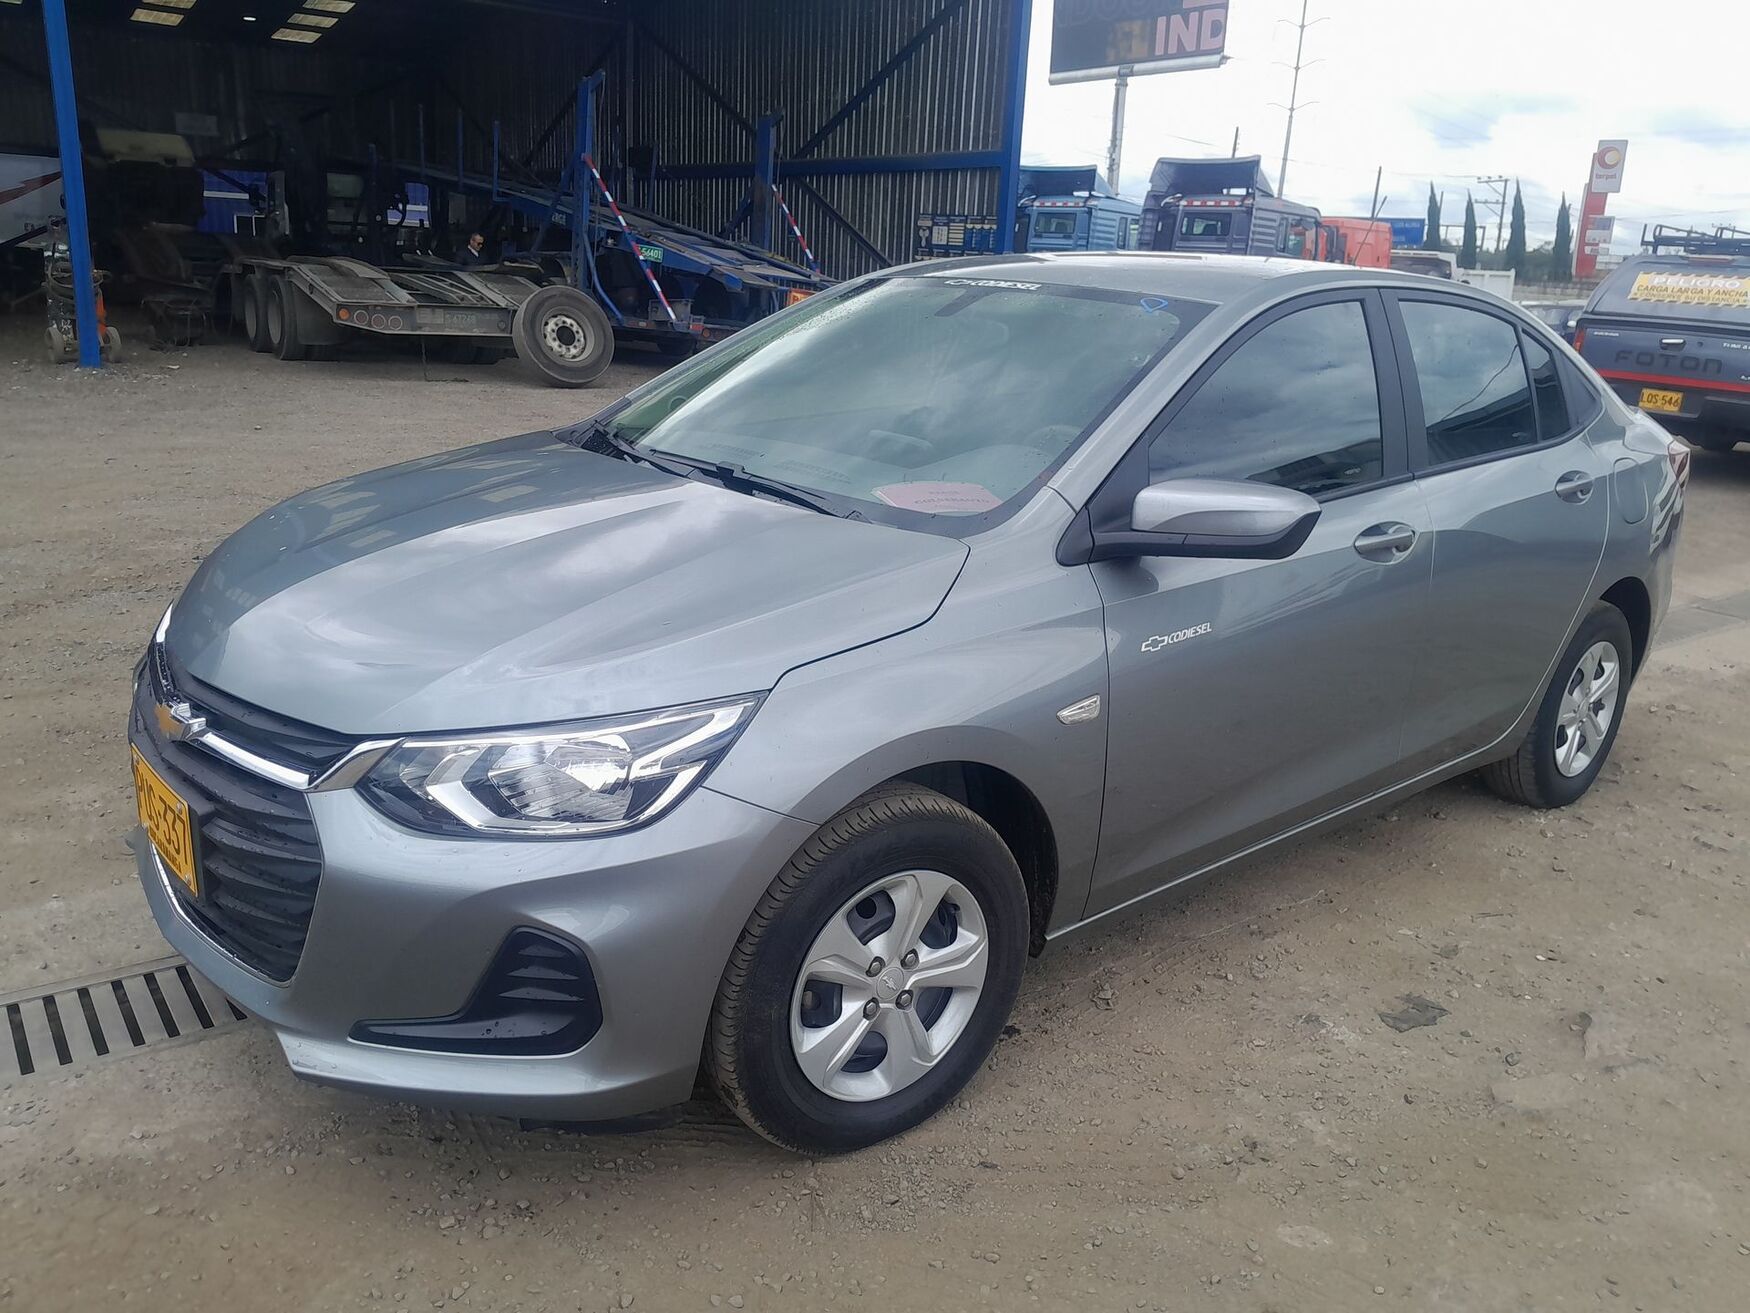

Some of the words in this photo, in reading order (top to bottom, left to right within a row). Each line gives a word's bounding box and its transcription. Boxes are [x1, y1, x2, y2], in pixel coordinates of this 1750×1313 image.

[1155, 8, 1226, 55] IND
[641, 247, 662, 259] 56401
[1636, 284, 1669, 293] CARGA
[1670, 286, 1704, 295] LARGA
[1707, 288, 1714, 296] Y
[1714, 289, 1749, 298] ANCHA
[1614, 350, 1723, 374] FOTON
[1168, 622, 1213, 644] CODIESEL
